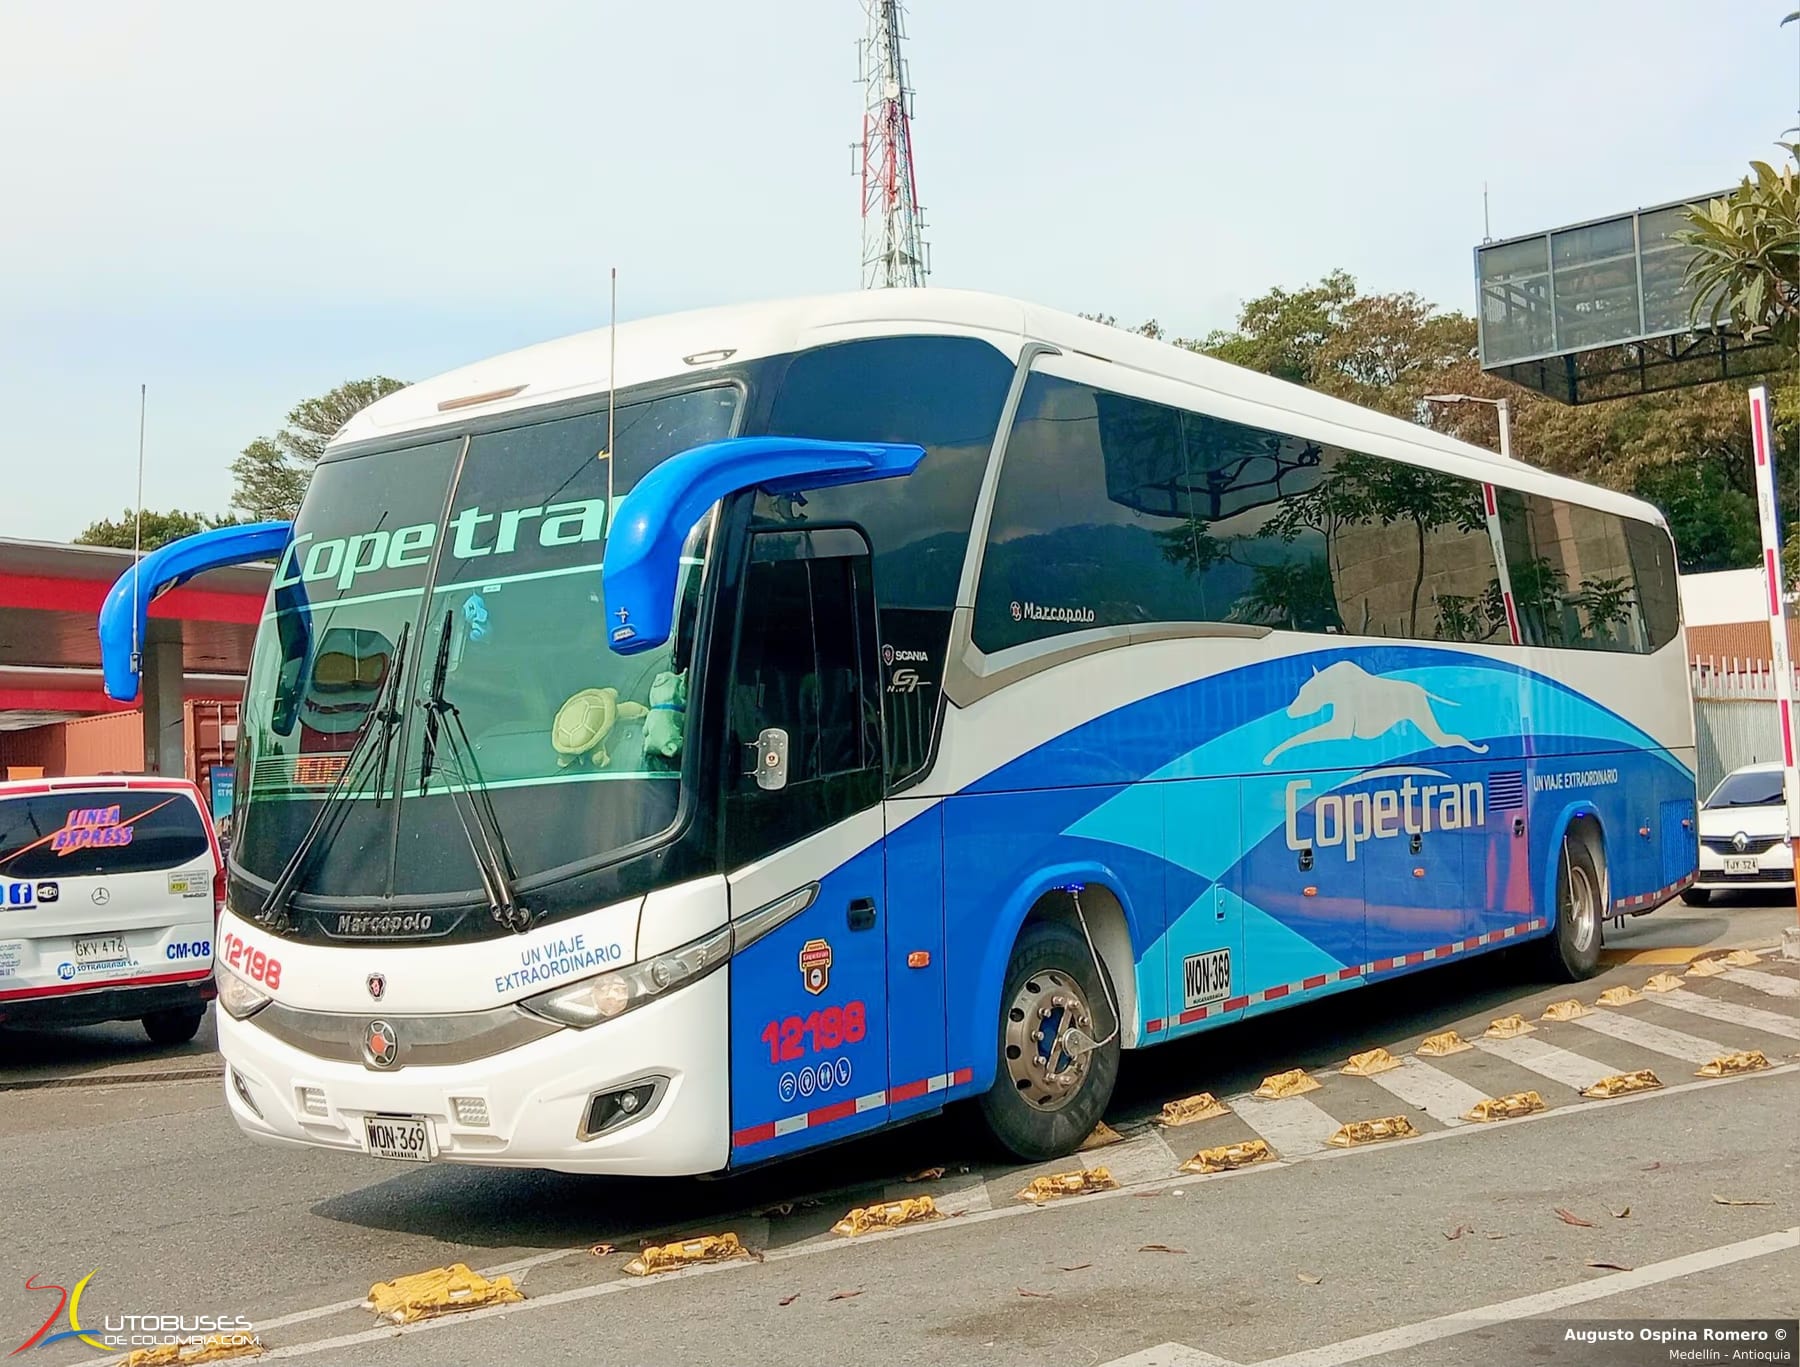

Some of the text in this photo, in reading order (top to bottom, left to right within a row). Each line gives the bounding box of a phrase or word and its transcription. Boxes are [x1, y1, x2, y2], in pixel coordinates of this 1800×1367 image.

[275, 494, 628, 590] Copetra
[1024, 602, 1095, 623] Marcopolo
[895, 650, 928, 661] SCANIA
[1544, 773, 1563, 791] VIAJE
[1564, 768, 1618, 789] EXTRAORDINARIO
[70, 808, 119, 826] LINEA
[1286, 776, 1485, 862] Copetran
[55, 827, 134, 848] EXPRESS
[337, 912, 432, 934] Marcopolo
[224, 932, 282, 990] 12198
[521, 934, 585, 966] UN VIAJE
[495, 943, 622, 993] EXTRAORDINARIO
[761, 1001, 867, 1064] 12198
